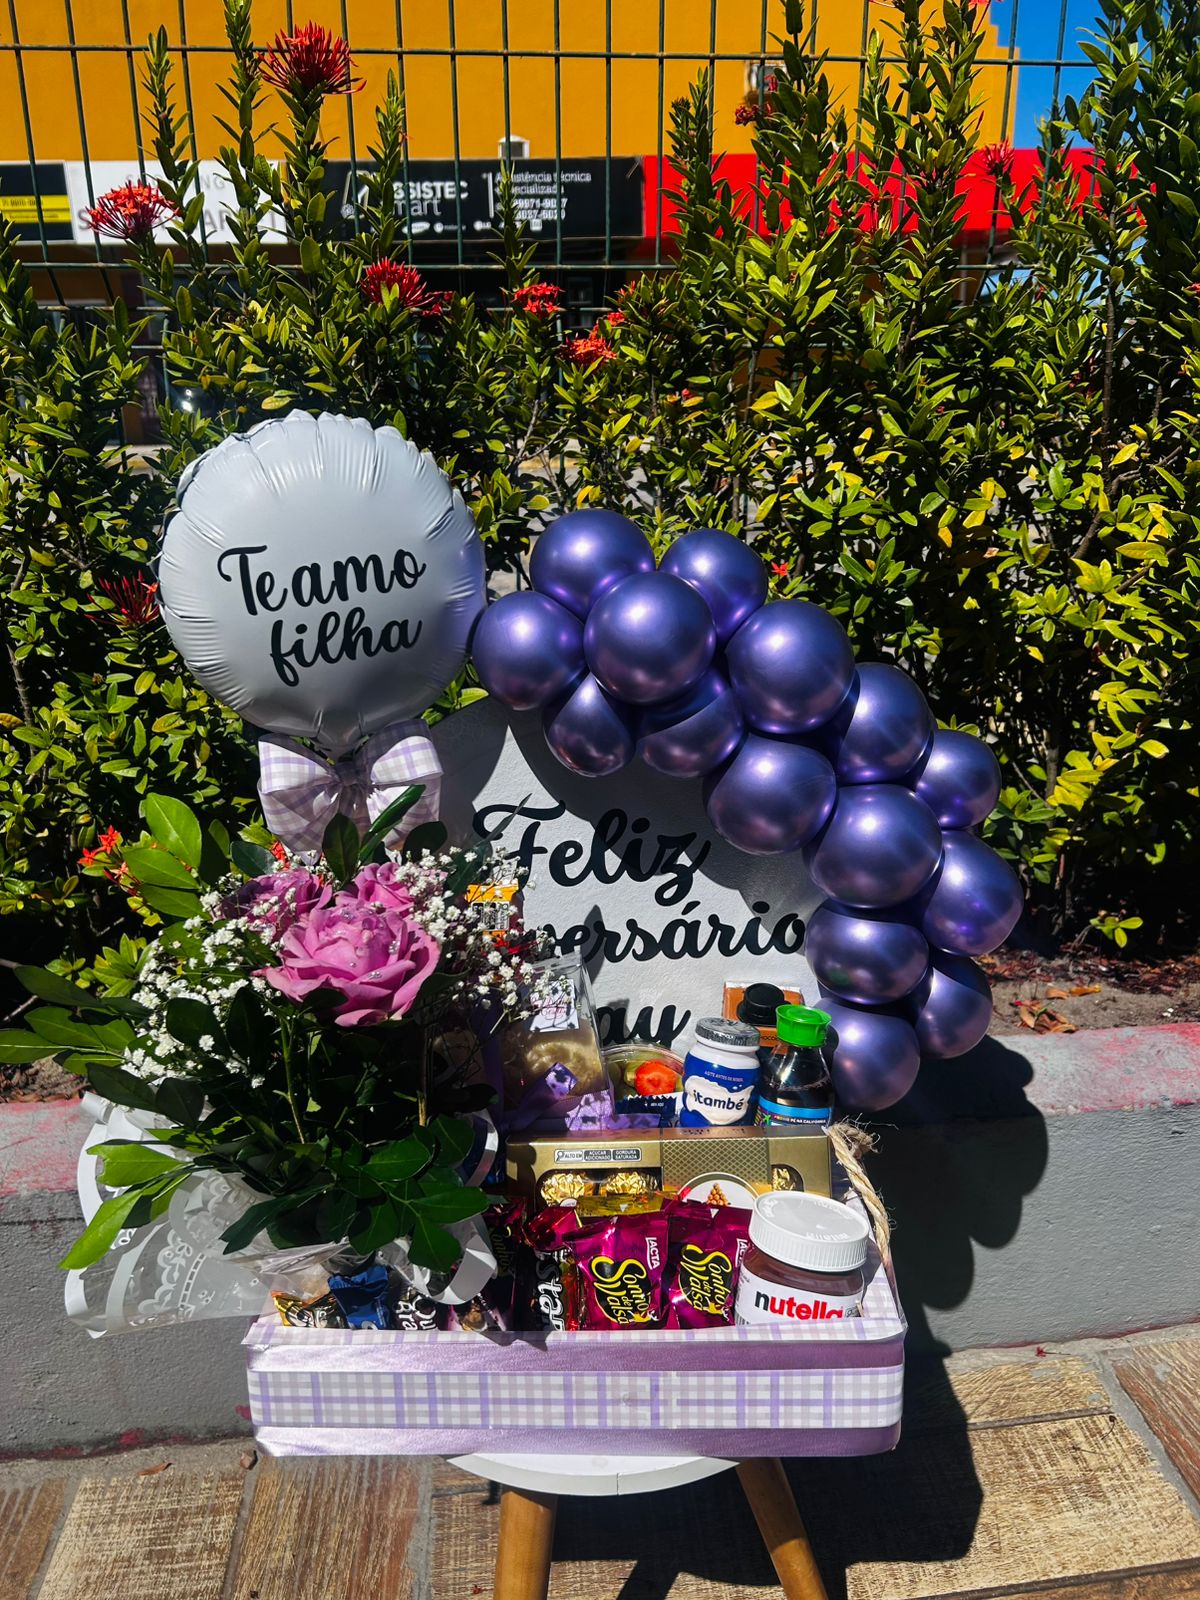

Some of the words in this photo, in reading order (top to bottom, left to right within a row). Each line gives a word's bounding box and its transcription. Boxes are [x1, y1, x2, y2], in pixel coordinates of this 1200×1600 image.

[393, 181, 469, 199] SSISTEC
[393, 198, 441, 215] mart
[270, 607, 423, 687] filha
[472, 800, 711, 907] Feliz
[594, 1004, 691, 1050] ay
[693, 1089, 744, 1111] itambé
[645, 1237, 661, 1270] LACTA
[736, 1238, 748, 1267] LAC
[681, 1244, 733, 1306] Sonho
[754, 1290, 844, 1320] nutella
